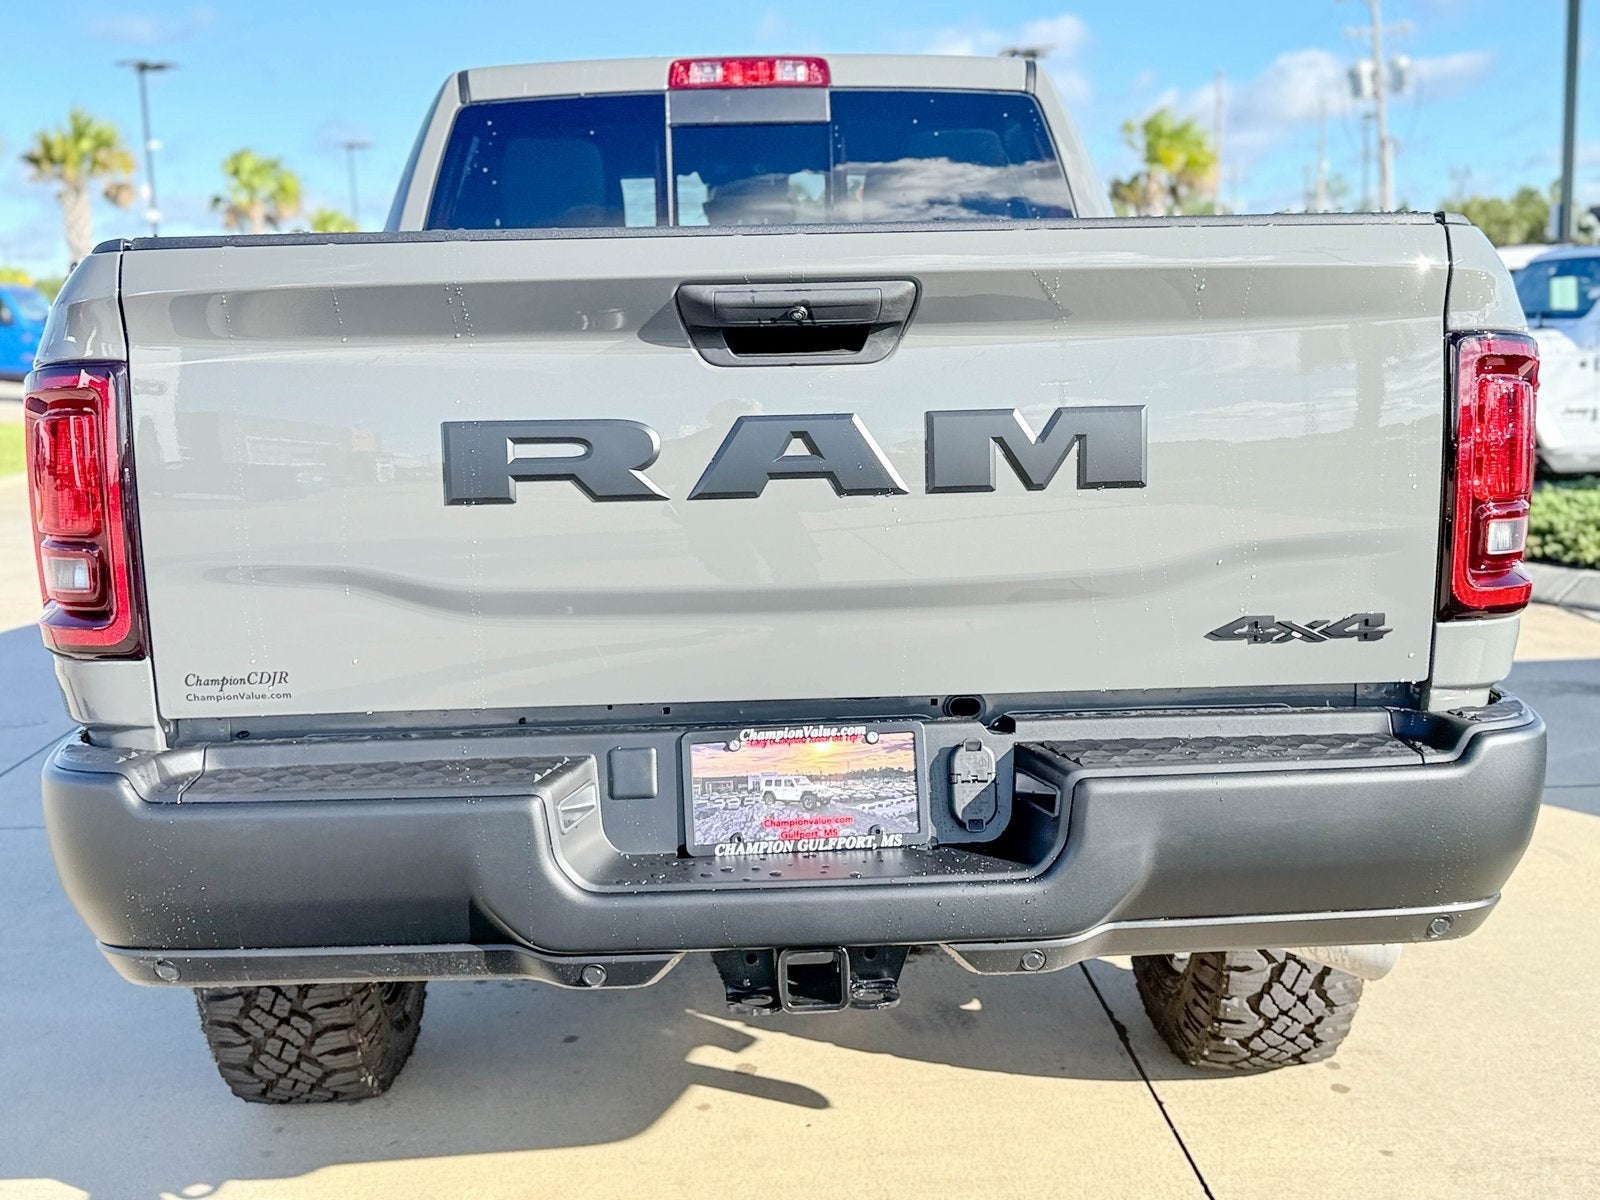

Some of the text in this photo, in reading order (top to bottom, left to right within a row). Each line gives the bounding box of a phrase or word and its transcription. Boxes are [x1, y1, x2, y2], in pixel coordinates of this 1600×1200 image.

[442, 404, 1148, 506] RAM
[184, 671, 289, 692] ChampionCDJR
[186, 691, 292, 703] ChampionValue.com
[740, 725, 867, 742] ChampionValue.com
[824, 828, 838, 837] MS
[714, 834, 903, 857] CHAMPION GULFPORT, MS
